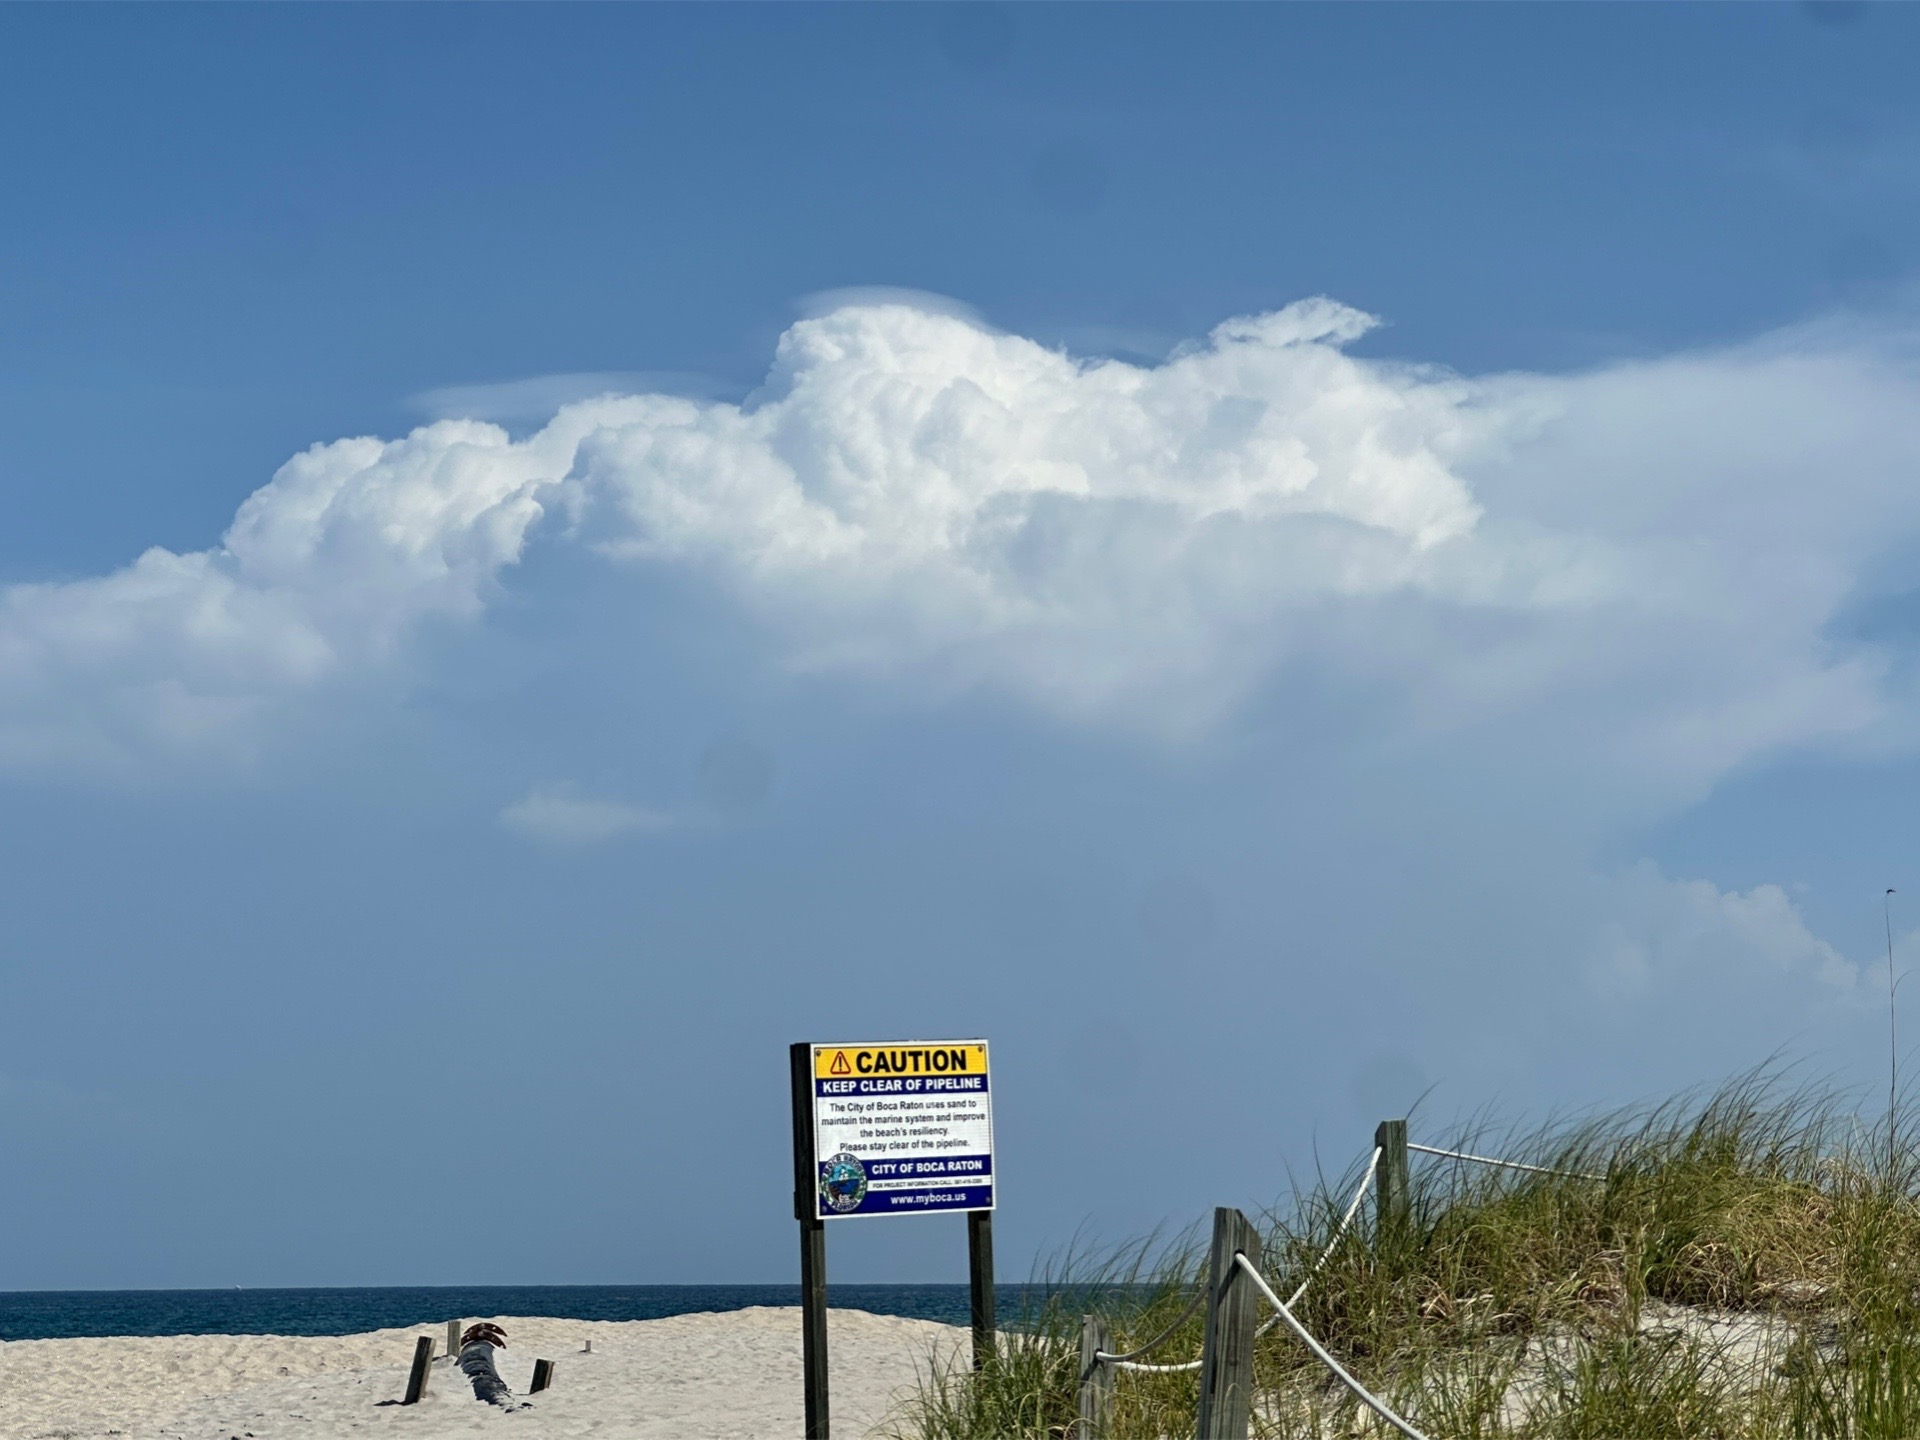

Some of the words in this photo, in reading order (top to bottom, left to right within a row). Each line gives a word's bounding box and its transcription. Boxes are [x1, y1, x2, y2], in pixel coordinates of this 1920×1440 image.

[856, 1049, 967, 1074] CAUTION
[822, 1081, 857, 1093] KEEP
[860, 1080, 902, 1092] CLEAR
[905, 1079, 922, 1091] OF
[925, 1077, 982, 1090] PIPELINE
[830, 1103, 846, 1112] The
[847, 1102, 864, 1113] City
[866, 1102, 875, 1111] of
[877, 1101, 898, 1111] Boca
[900, 1100, 924, 1110] Raton
[926, 1101, 945, 1109] uses
[947, 1099, 967, 1108] sand
[968, 1099, 977, 1108] to
[821, 1115, 857, 1126] maintain
[859, 1115, 873, 1124] the
[875, 1114, 903, 1124] marine
[905, 1113, 934, 1125] system
[936, 1112, 951, 1122] and
[953, 1111, 986, 1123] improve
[860, 1129, 874, 1138] the
[875, 1127, 908, 1137] beach's
[909, 1125, 950, 1137] resiliency.
[840, 1142, 868, 1151] Please
[869, 1141, 887, 1152] stay
[889, 1140, 910, 1150] clear
[911, 1139, 920, 1149] of
[921, 1139, 934, 1148] the
[936, 1138, 970, 1150] pipeline.
[871, 1163, 897, 1175] CITY
[899, 1162, 914, 1174] OF
[916, 1161, 946, 1173] BOCA
[947, 1159, 983, 1171] RATON
[884, 1181, 906, 1189] PROJECT
[907, 1179, 939, 1187] INFORMATION
[890, 1192, 967, 1206] www.myboca.us
